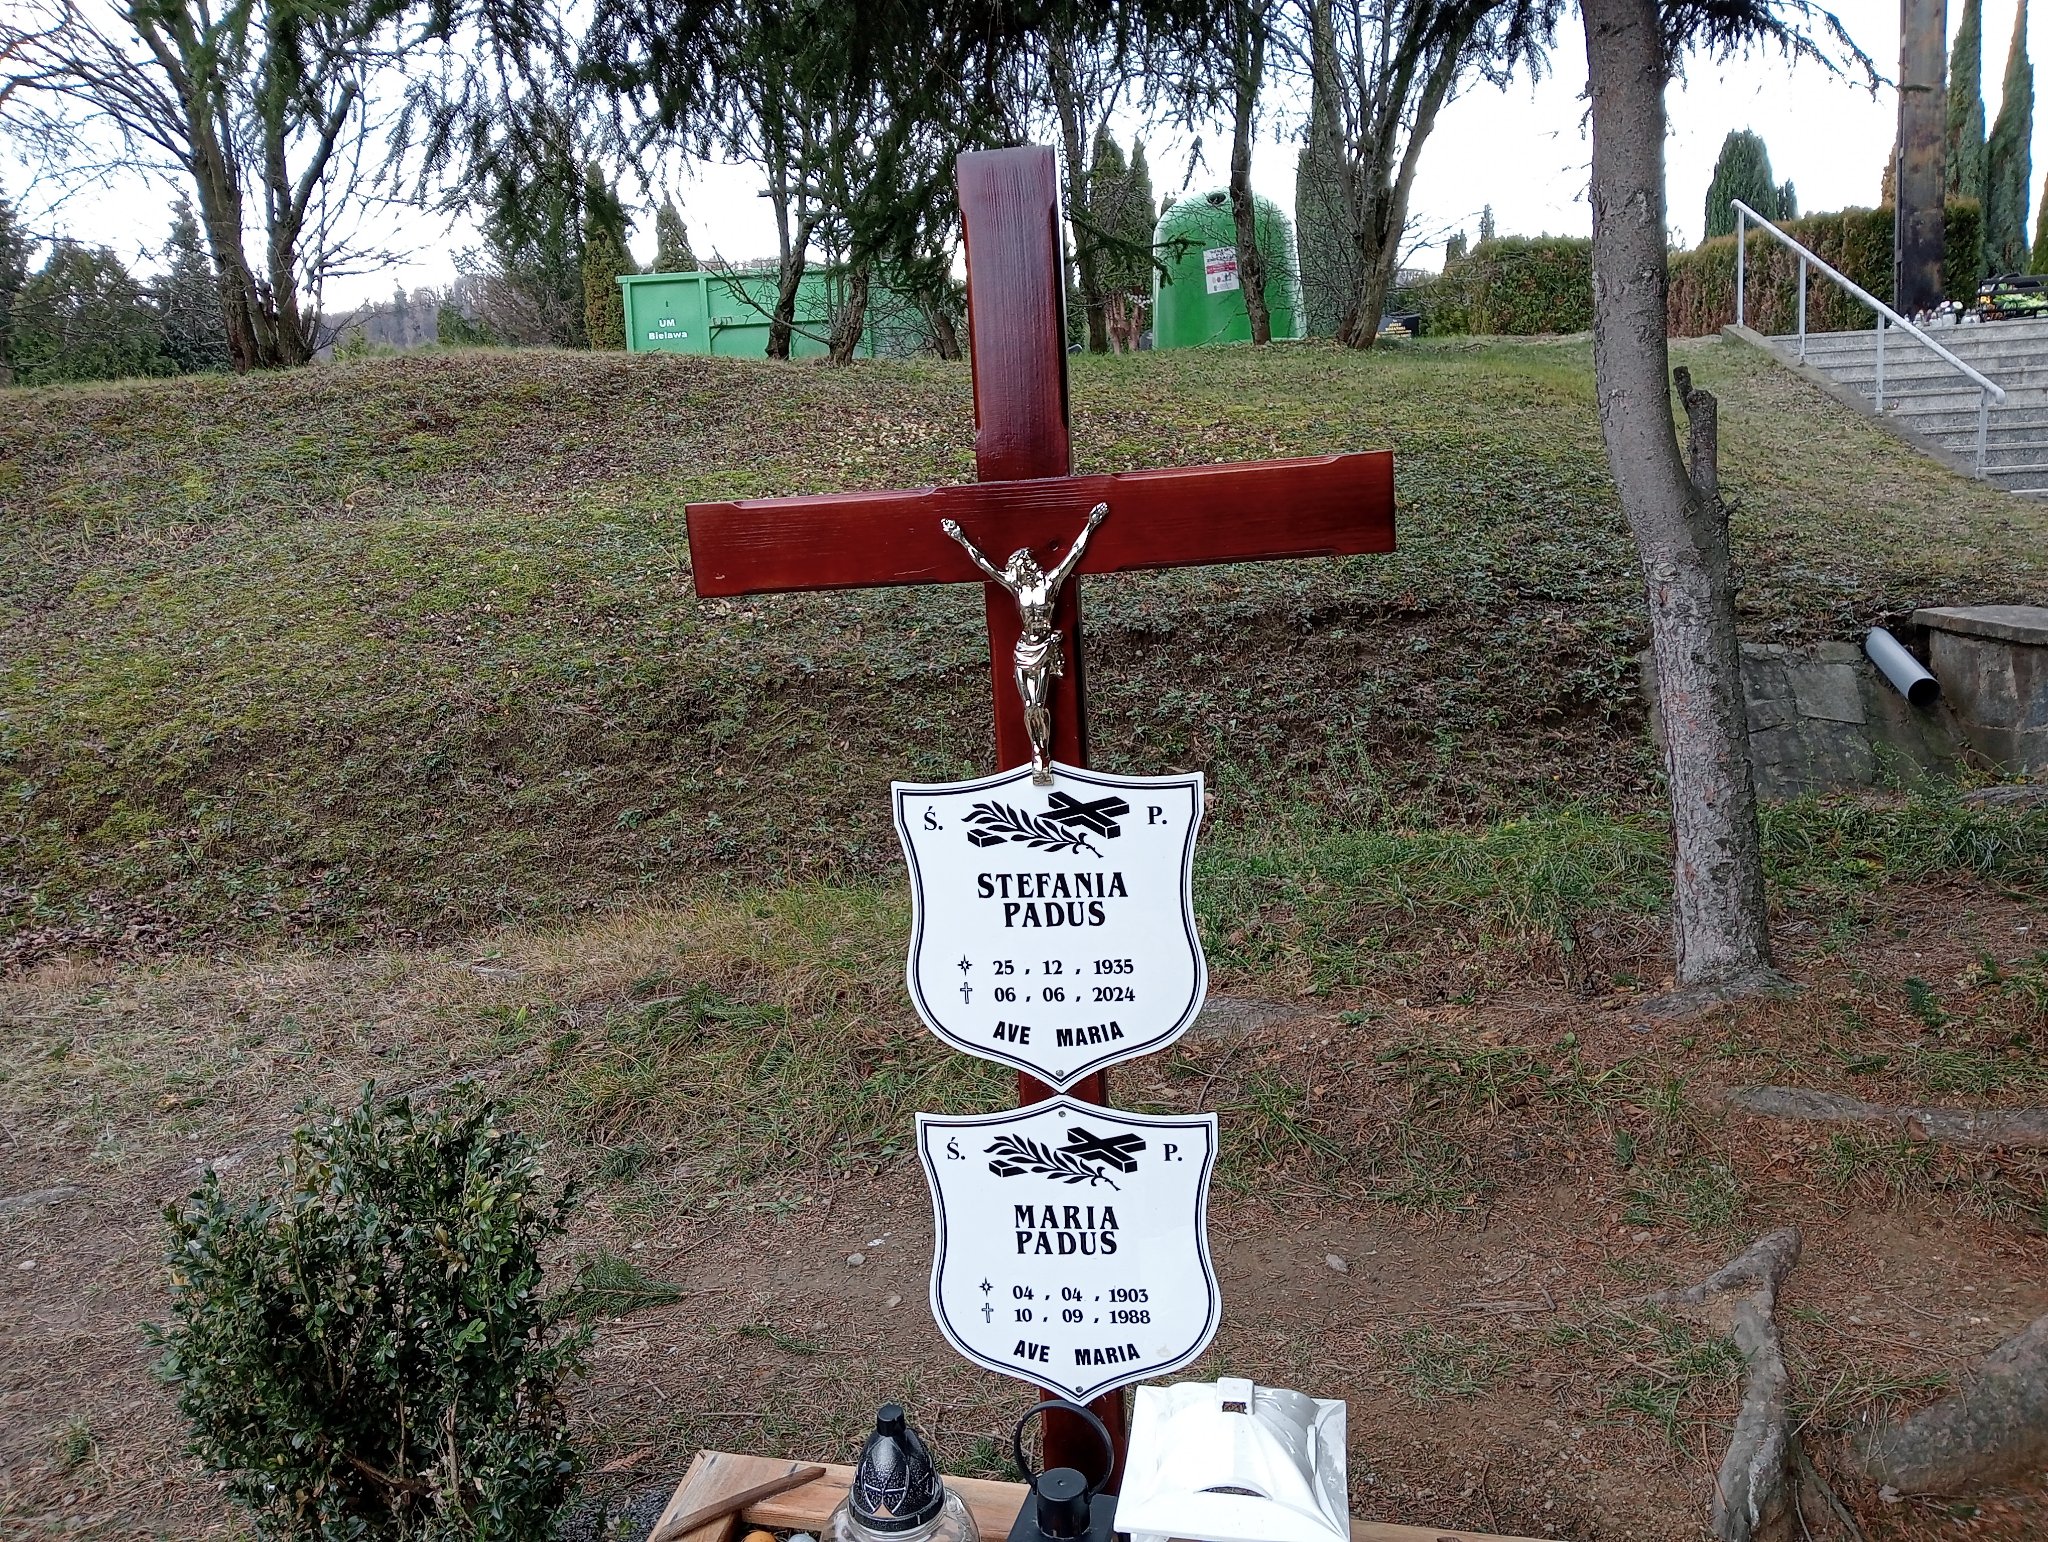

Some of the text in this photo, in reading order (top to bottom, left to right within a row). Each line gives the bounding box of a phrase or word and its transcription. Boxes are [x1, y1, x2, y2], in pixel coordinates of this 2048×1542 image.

[648, 331, 688, 340] Bielawa
[659, 318, 676, 328] UM
[1147, 805, 1168, 825] P.
[977, 871, 1129, 899] STEFANIA
[1003, 900, 1106, 928] PADUS
[992, 1020, 1125, 1048] AVE MARIA
[1163, 1143, 1183, 1162] P.
[1013, 1204, 1120, 1230] MARIA
[1015, 1230, 1118, 1256] PADUS
[1013, 1339, 1141, 1366] AVE MARIA
